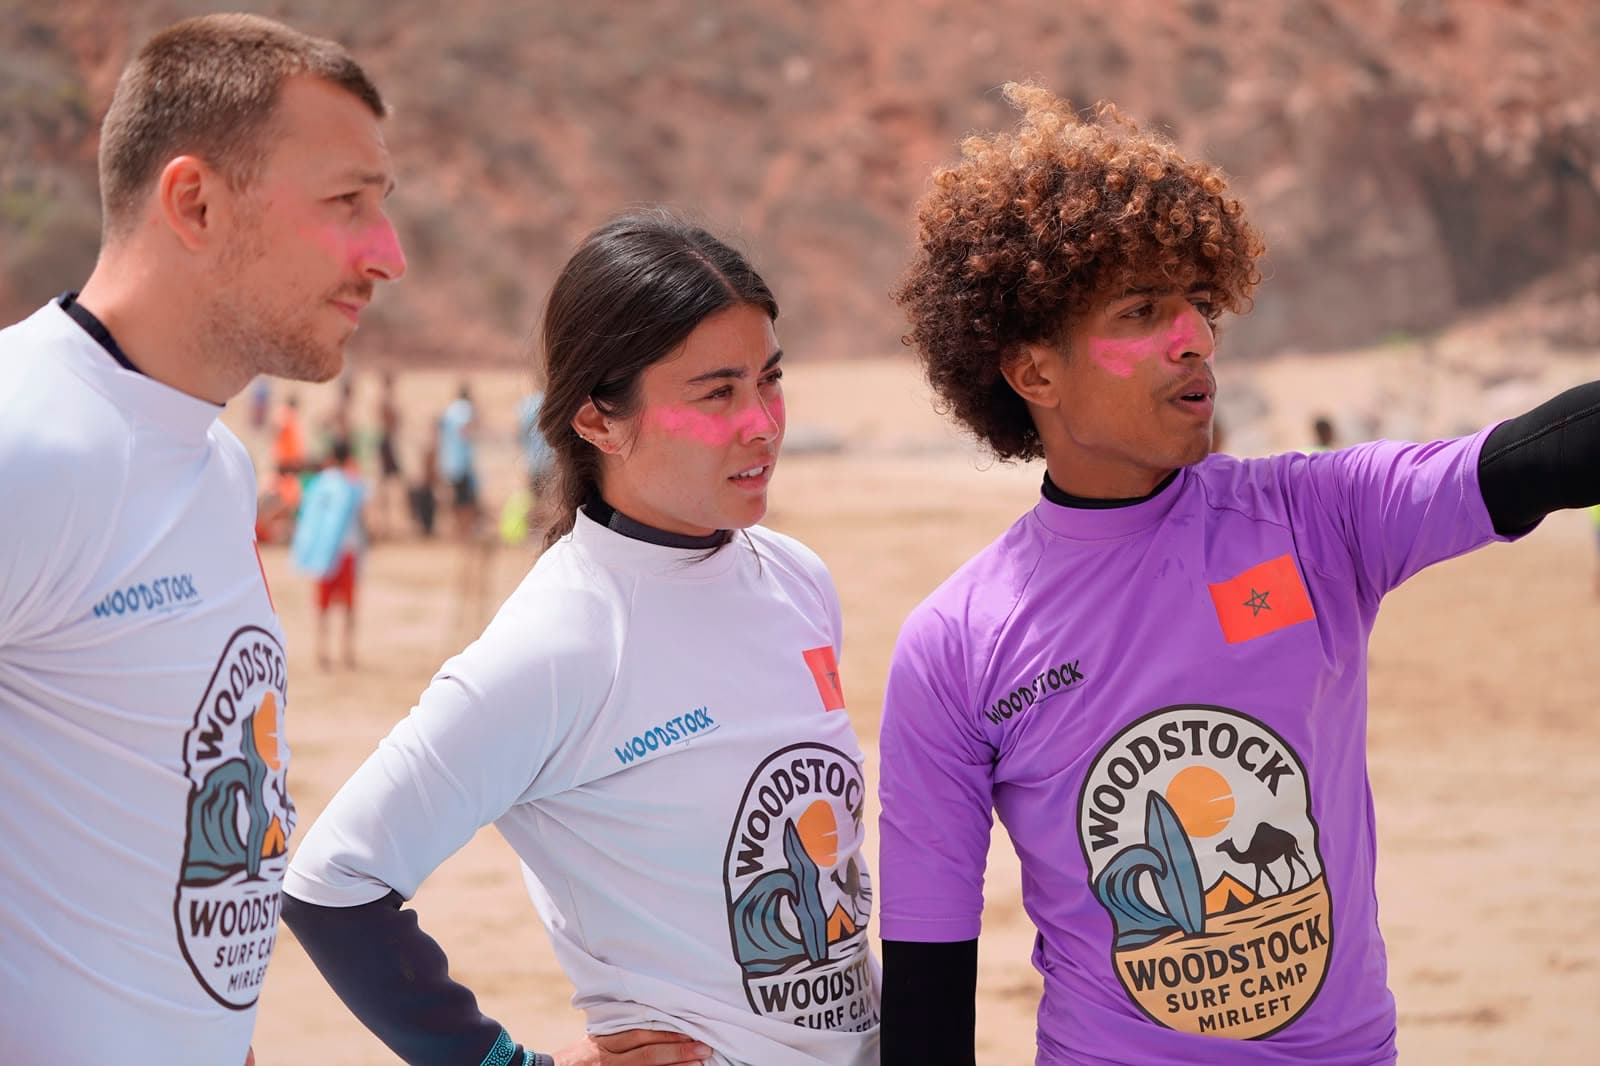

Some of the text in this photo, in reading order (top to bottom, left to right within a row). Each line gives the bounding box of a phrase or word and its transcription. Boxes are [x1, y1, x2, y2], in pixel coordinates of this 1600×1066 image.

[93, 574, 198, 618] WOODSTOCK
[196, 642, 286, 761] WOODSTO
[983, 659, 1084, 725] WOODSTOCK
[614, 706, 714, 765] WOODSTOCK
[1088, 720, 1296, 852] WOODSTOCK
[190, 892, 280, 937] WOODST
[214, 941, 255, 968] SURF
[1124, 913, 1328, 992] WOODSTOCK
[1166, 962, 1308, 1014] SURF CAMP
[1198, 995, 1292, 1033] MIRLEFT
